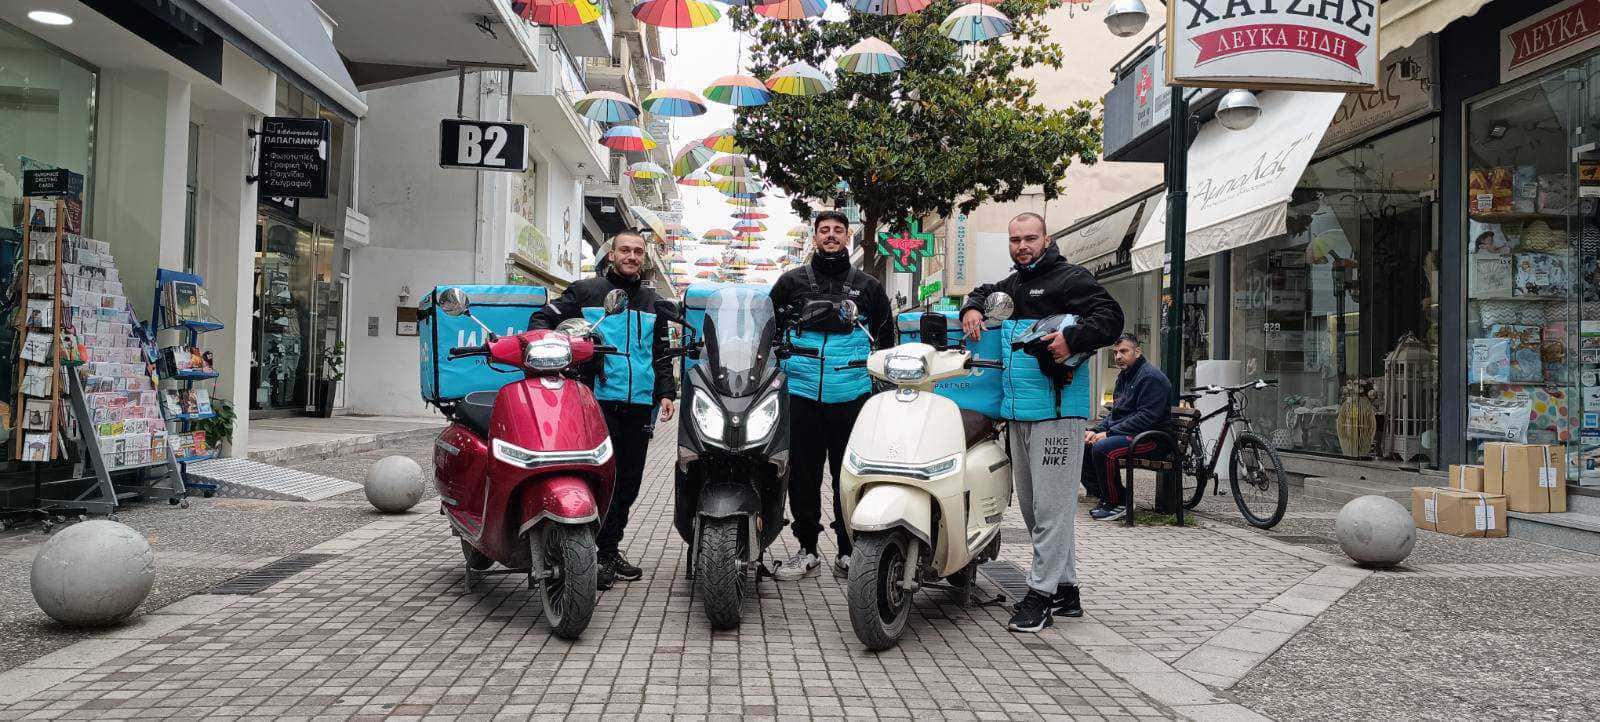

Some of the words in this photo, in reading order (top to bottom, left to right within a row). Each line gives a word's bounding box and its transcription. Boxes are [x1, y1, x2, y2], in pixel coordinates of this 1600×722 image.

[1518, 7, 1588, 59] ΛΕΥΚΑ
[1216, 28, 1288, 52] ΛΕΥΚΑ
[1297, 29, 1347, 58] ΕΙΔΗ
[264, 136, 320, 145] ΠΑΠΑΓΙΑΝΝΗ
[457, 125, 508, 167] B2
[270, 179, 312, 189] Ζωγραφική
[1045, 437, 1069, 446] NIKE
[1044, 447, 1068, 455] NIKE
[1042, 456, 1067, 466] NIKE
